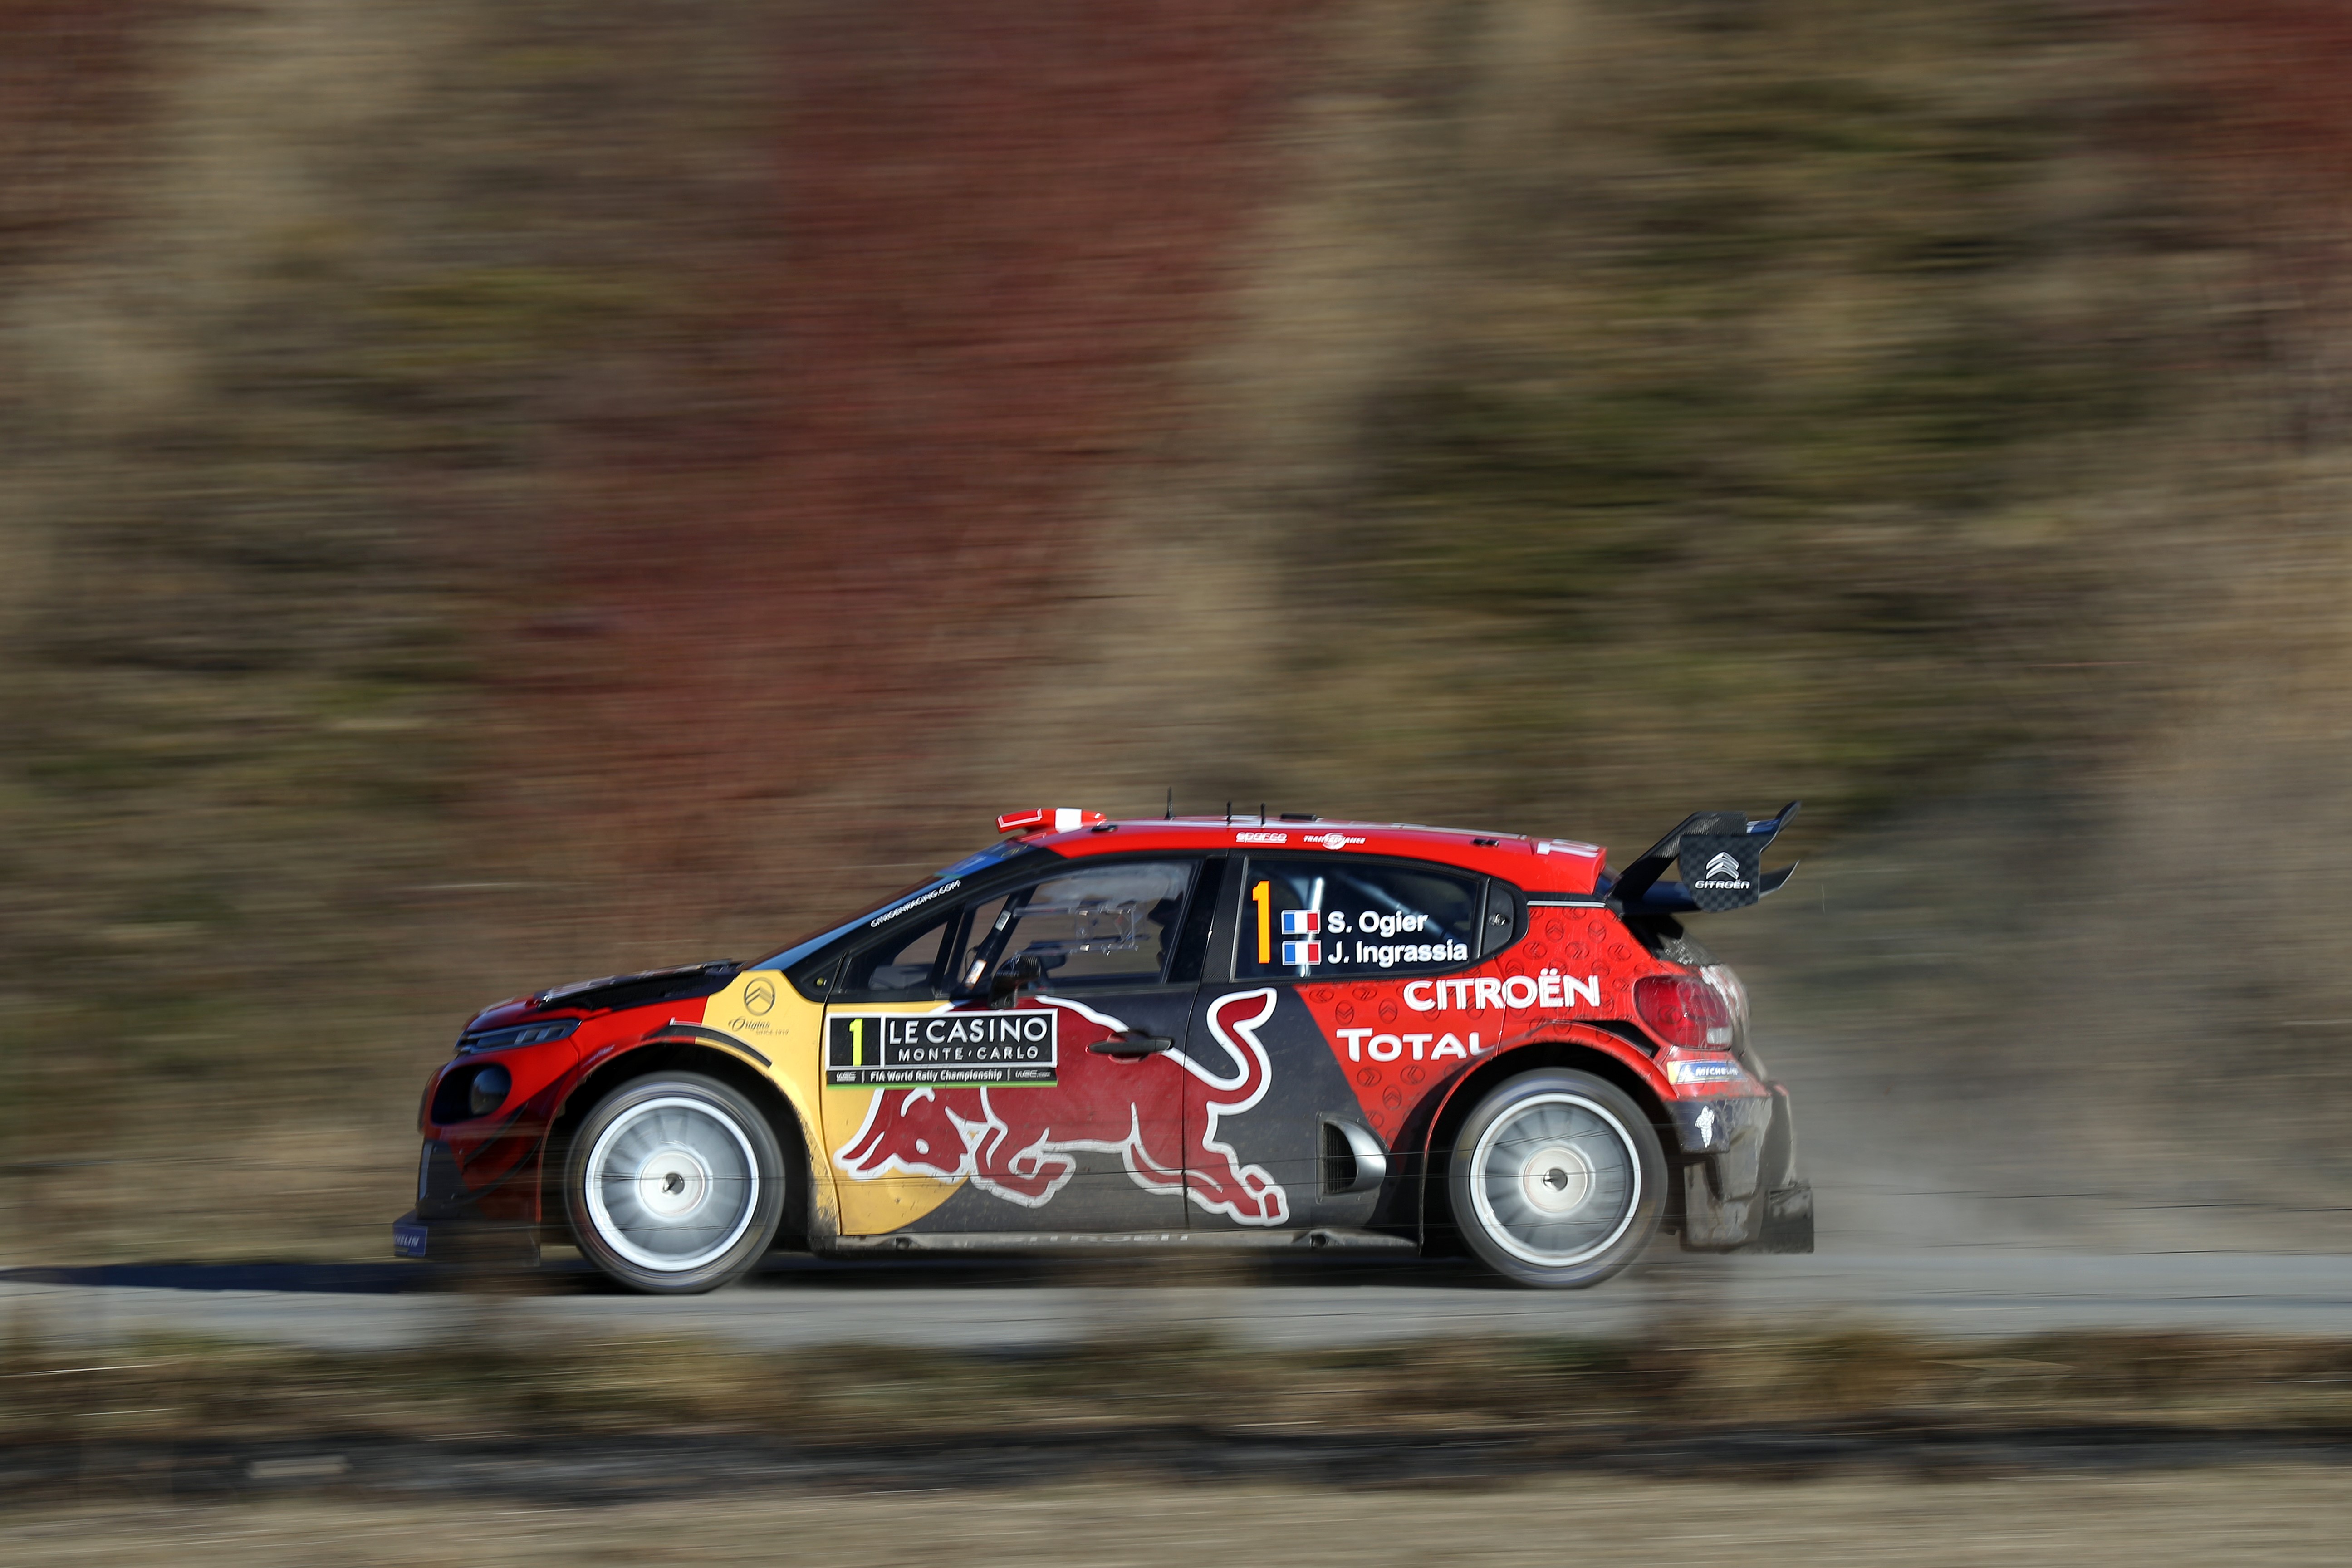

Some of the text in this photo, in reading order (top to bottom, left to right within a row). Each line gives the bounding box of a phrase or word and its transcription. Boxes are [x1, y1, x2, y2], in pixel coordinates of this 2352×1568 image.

[1236, 832, 1287, 844] sparco
[1252, 881, 1270, 964] 1
[1328, 909, 1428, 938] S. Ogier
[1328, 939, 1469, 968] J. Ingrassia
[1403, 968, 1601, 1012] CITROËN
[849, 1018, 863, 1067] 1
[889, 1017, 1048, 1044] LE CASINO
[1336, 1027, 1496, 1063] TOTAL
[898, 1045, 1039, 1062] MONTE CARLO
[870, 1071, 885, 1082] FIA
[887, 1070, 913, 1082] World
[915, 1069, 938, 1082] Rally
[940, 1068, 1003, 1082] Championship
[1695, 1066, 1739, 1076] MICHELIN
